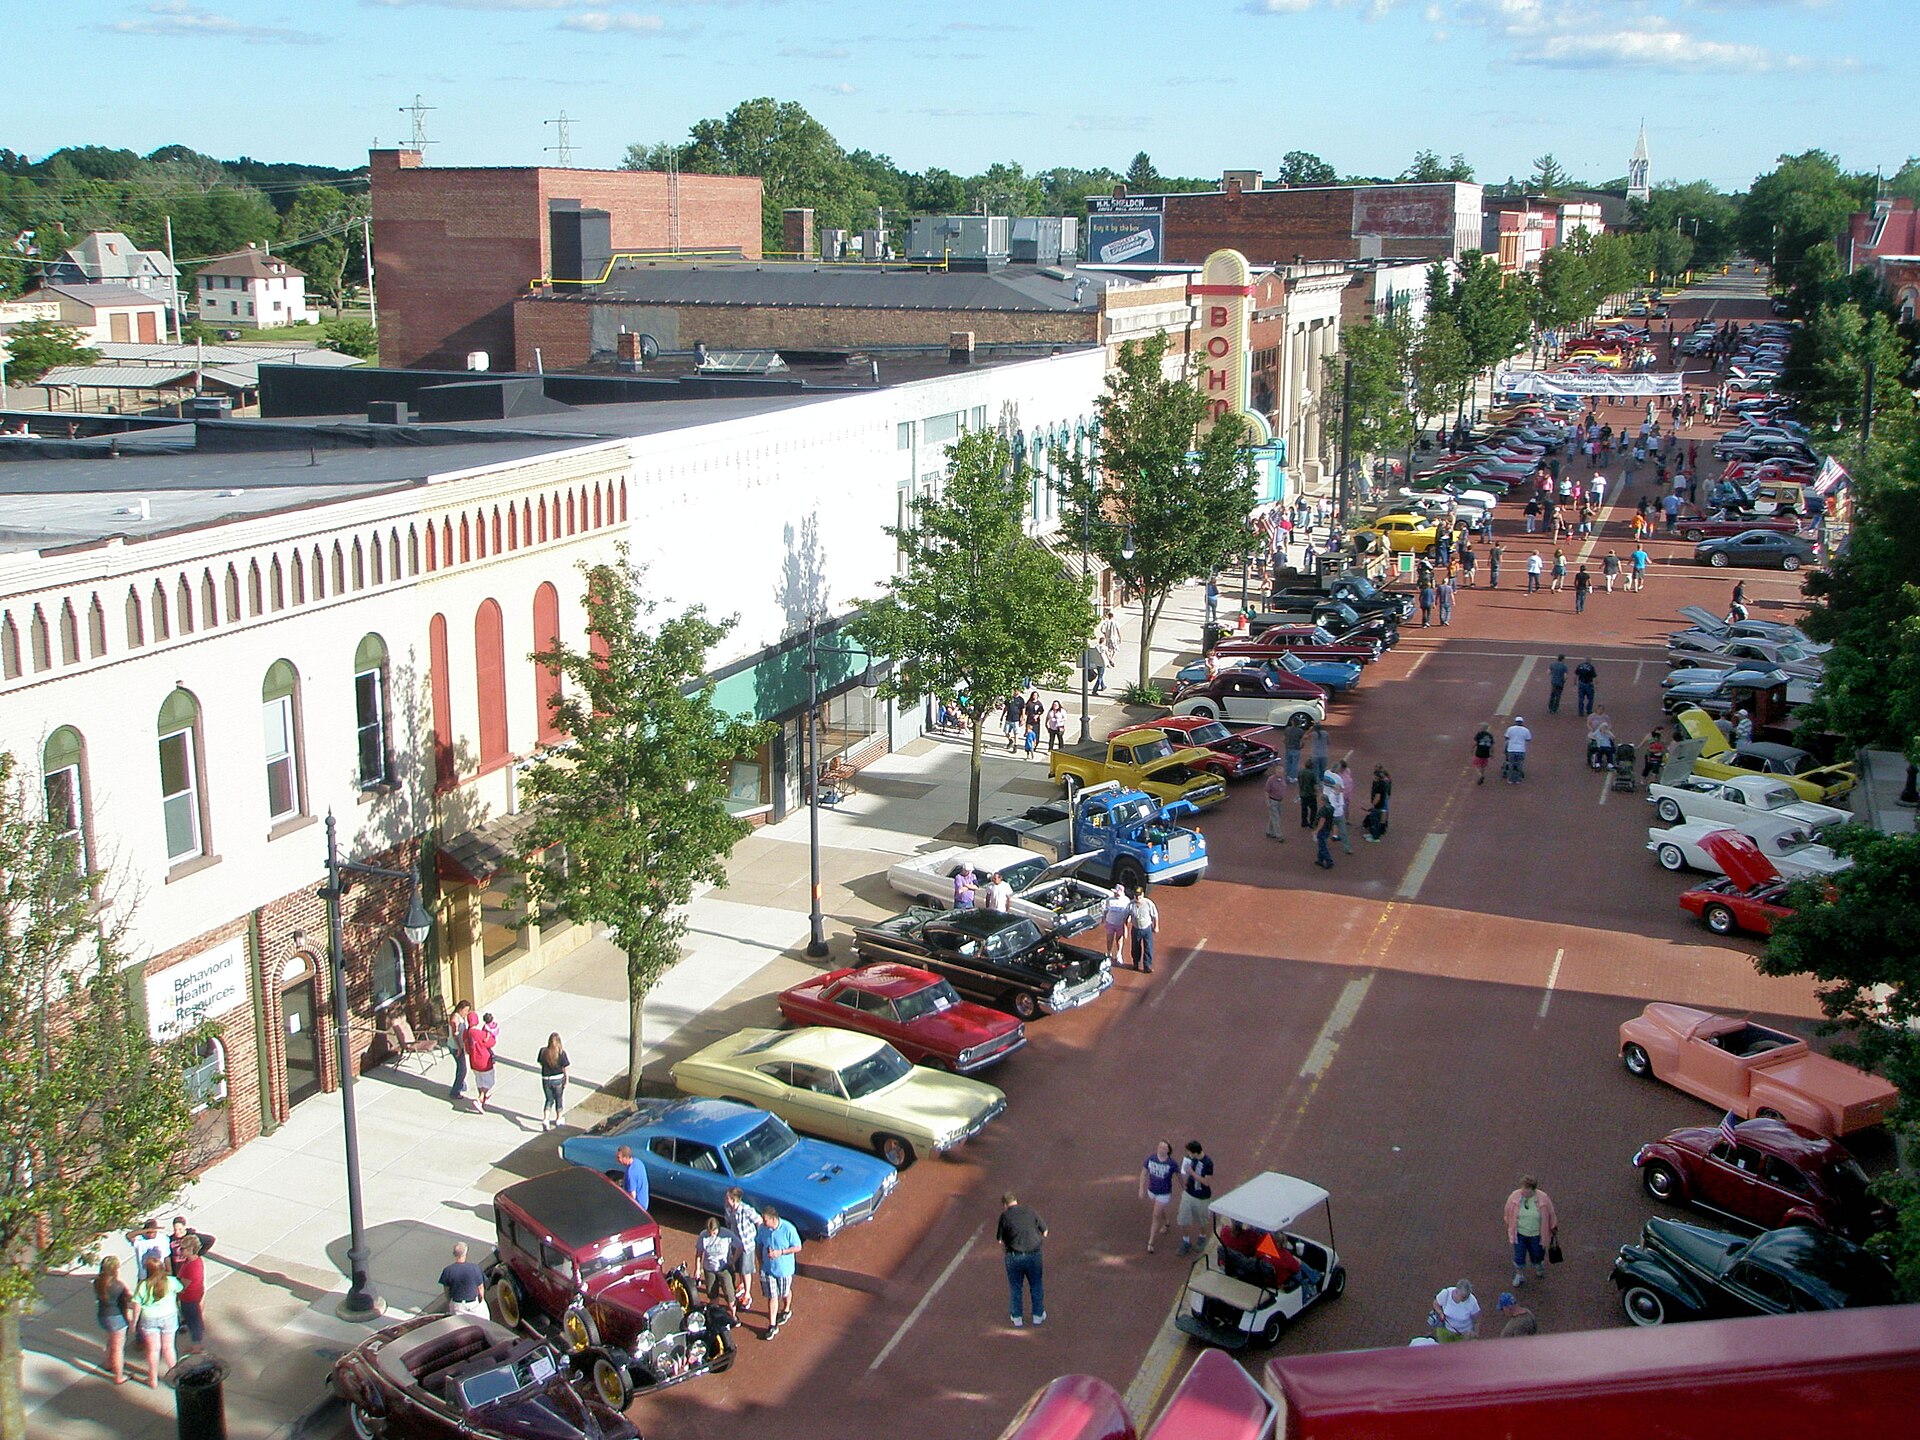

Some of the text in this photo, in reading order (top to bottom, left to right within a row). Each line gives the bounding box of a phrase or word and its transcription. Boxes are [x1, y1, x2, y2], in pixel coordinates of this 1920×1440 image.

[174, 954, 234, 993] Behavioral
[175, 980, 213, 1007] Health
[176, 984, 236, 1022] Resources
